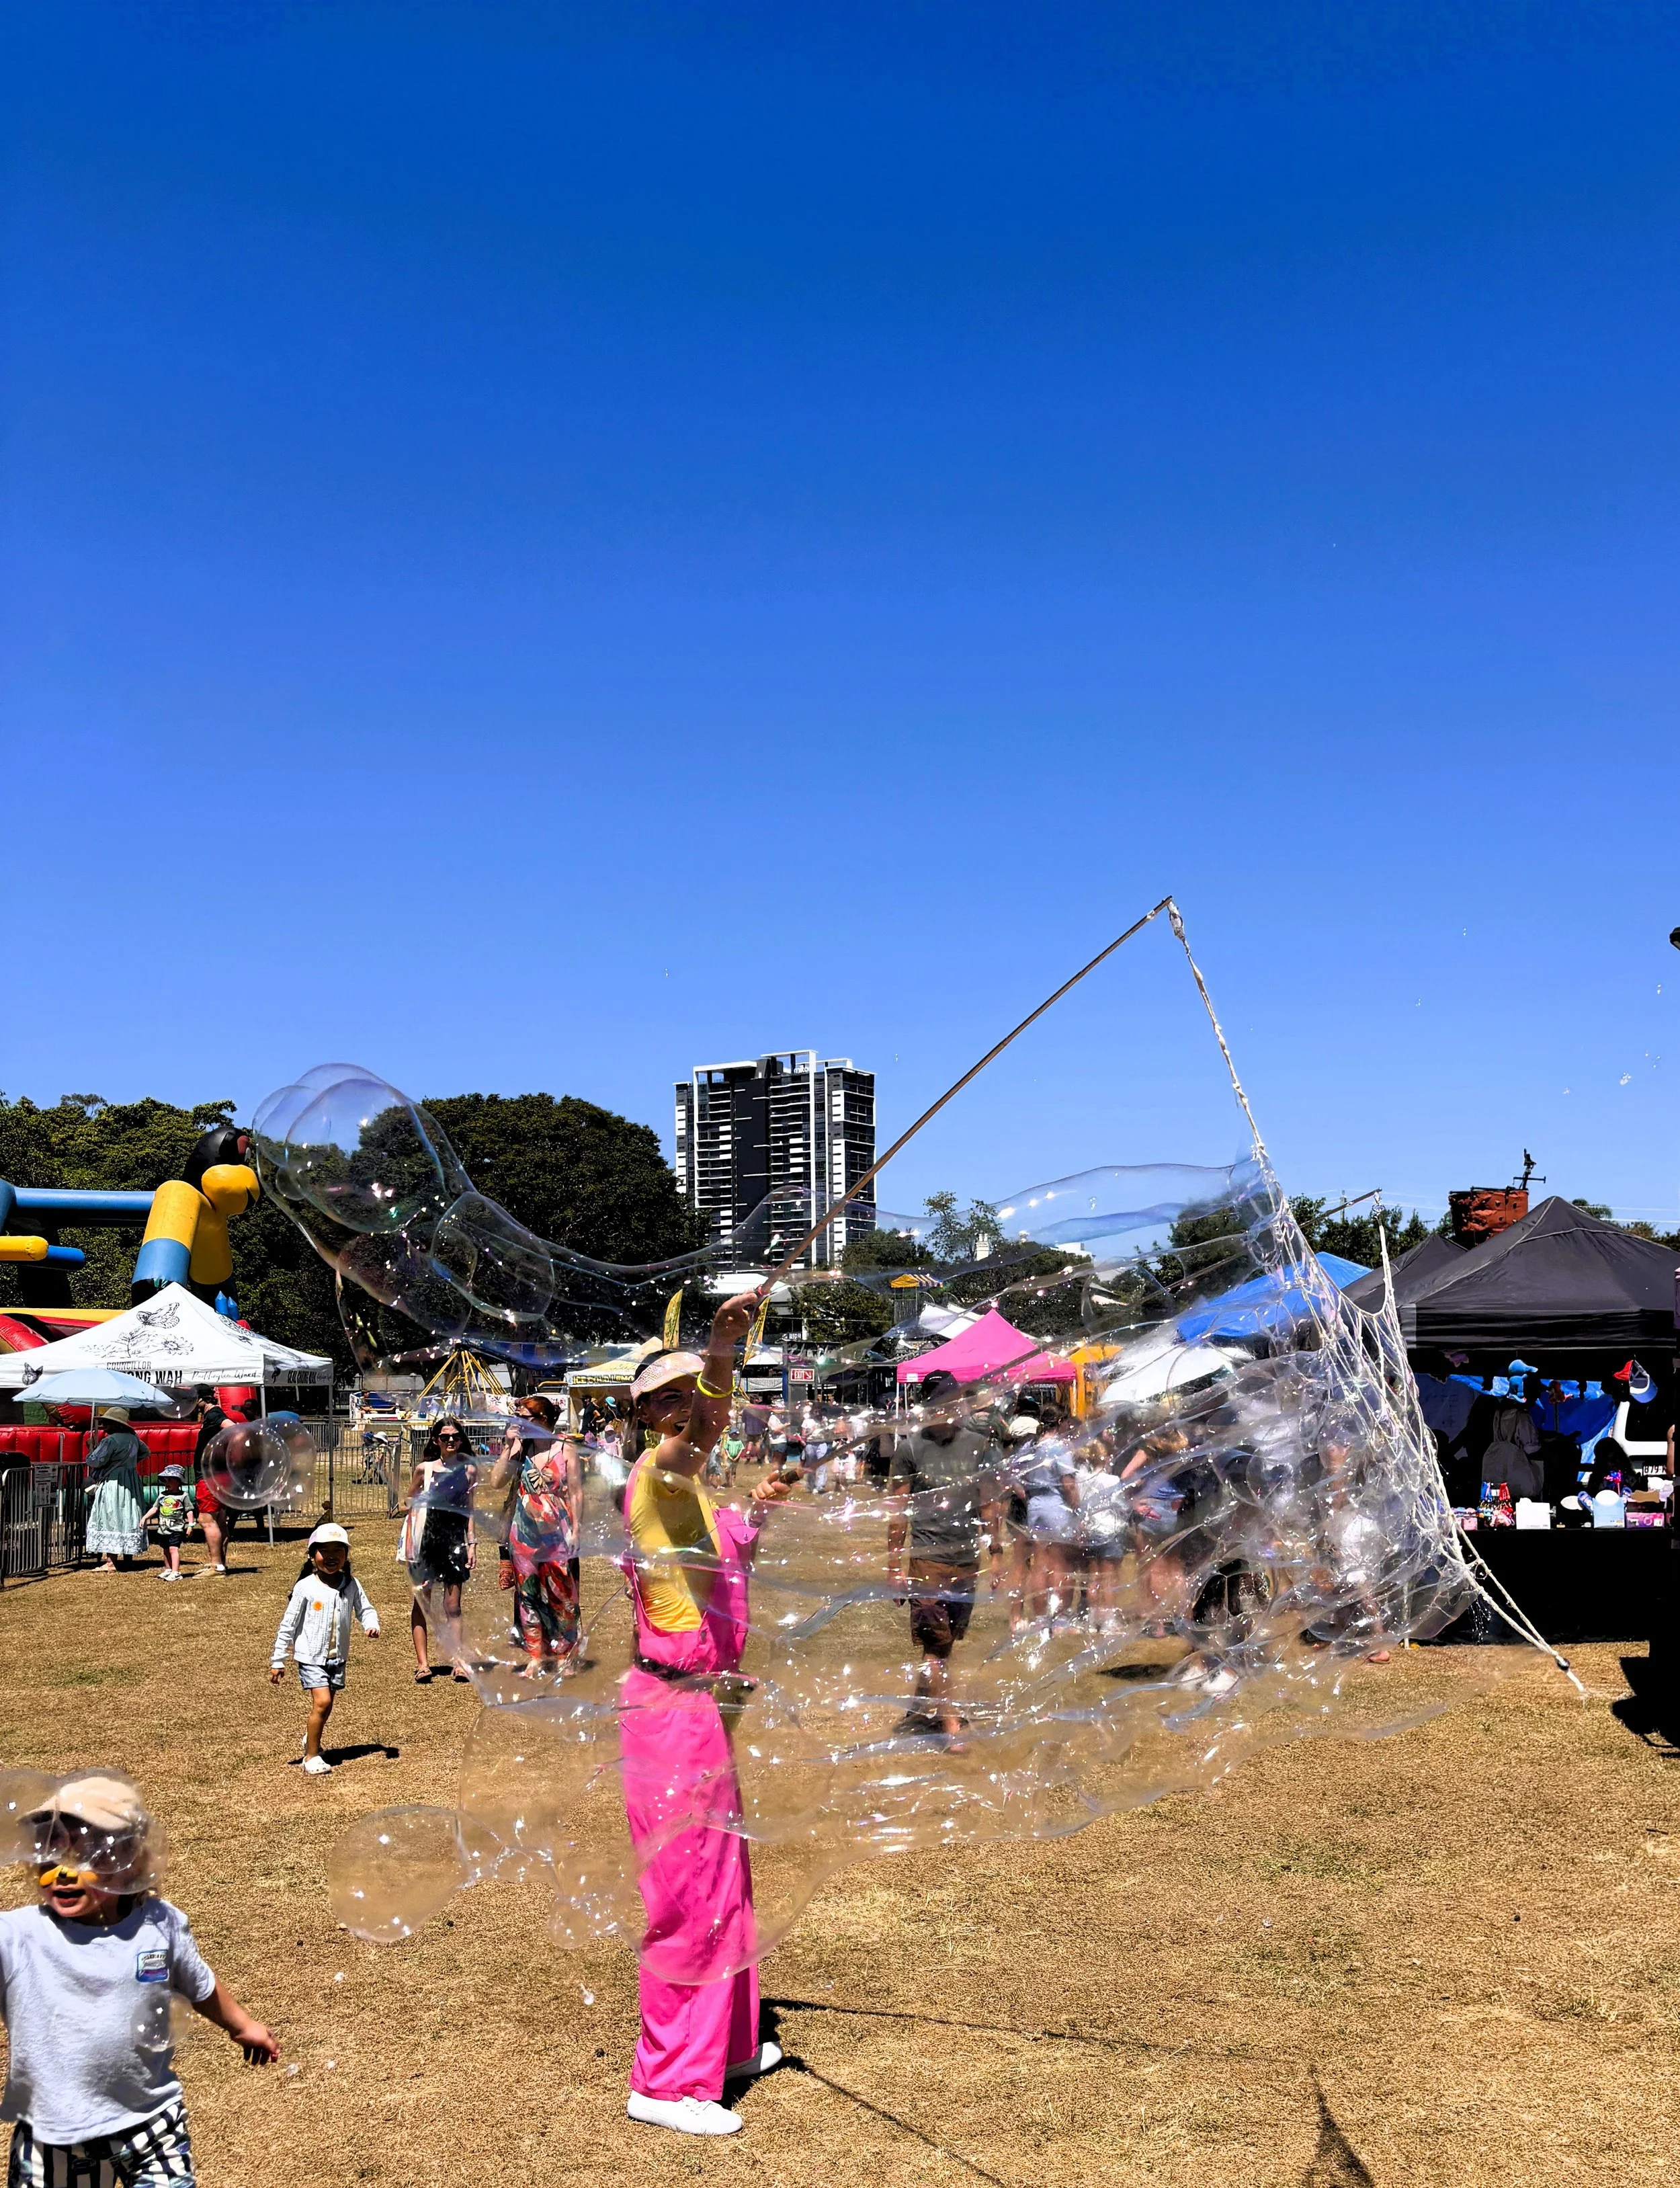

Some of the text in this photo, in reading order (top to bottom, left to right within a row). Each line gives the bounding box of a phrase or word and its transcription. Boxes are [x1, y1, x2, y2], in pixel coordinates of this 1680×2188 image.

[106, 1361, 151, 1371] COUNCILLOR
[155, 1370, 183, 1384] WAH
[235, 1369, 257, 1379] Ward
[794, 1370, 804, 1379] EXIT
[573, 1375, 587, 1384] ICE
